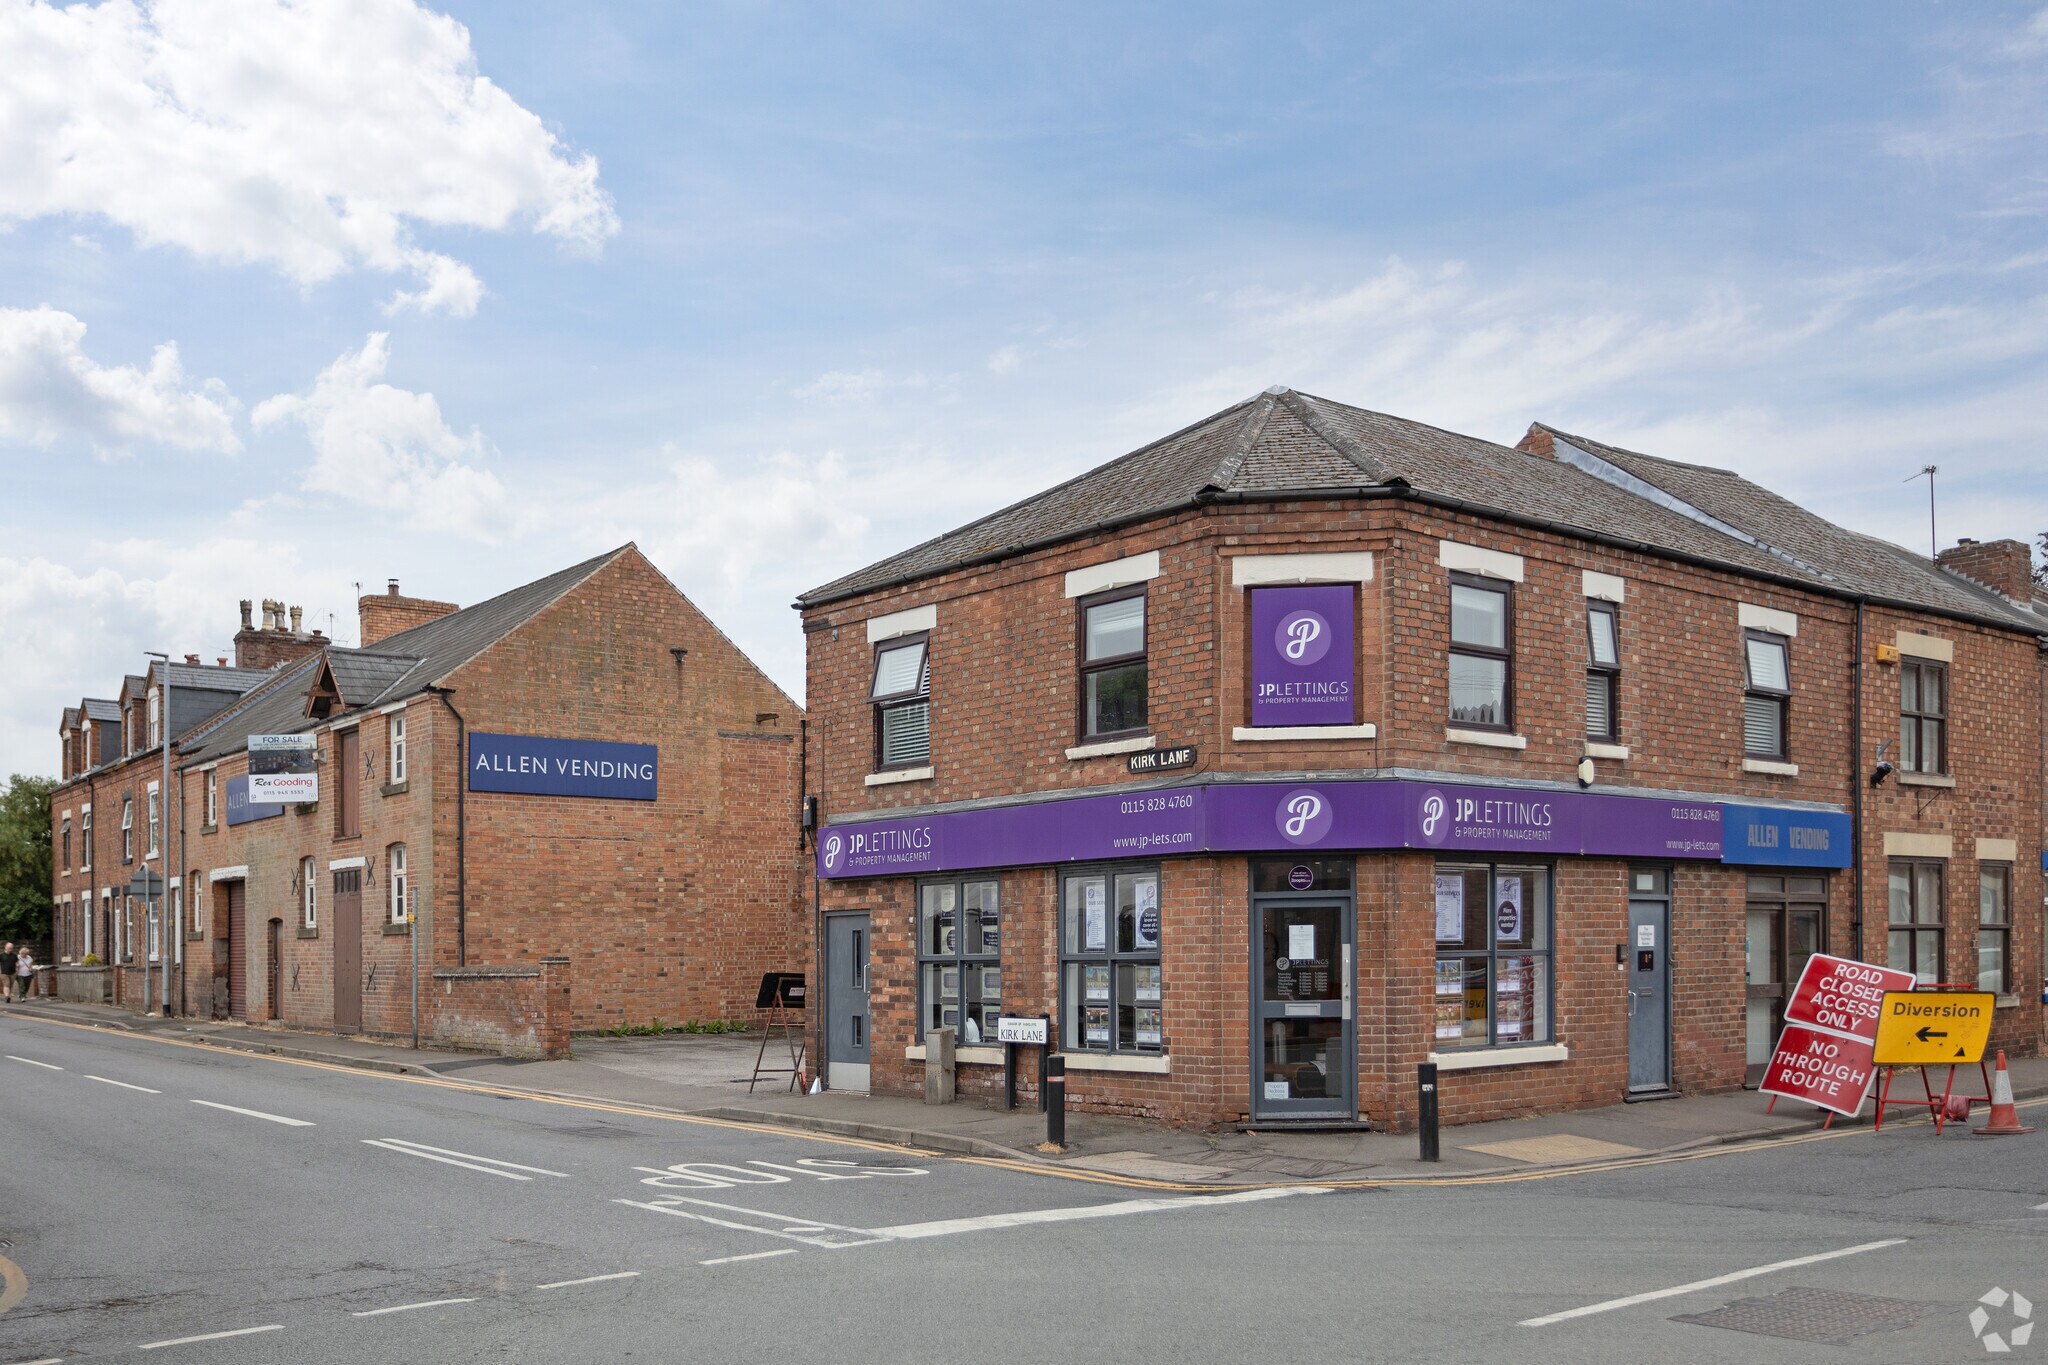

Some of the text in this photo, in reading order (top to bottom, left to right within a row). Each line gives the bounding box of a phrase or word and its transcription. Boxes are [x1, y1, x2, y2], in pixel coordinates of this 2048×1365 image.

[475, 753, 653, 780] ALLEN VENDING
[1130, 749, 1190, 769] KIRK LANE
[254, 778, 313, 787] Rex Gooding
[1121, 795, 1193, 814] 0115 828 4760
[1671, 808, 1720, 821] 0115 828 4760
[1113, 832, 1192, 849] www.jp-lets.com
[1455, 827, 1551, 841] & PROPERTY MANAGEMENT
[1747, 824, 1830, 850] ALLEN VENDING
[1665, 839, 1720, 852] www.jp-lets.com
[849, 851, 931, 866] & PROPERTY MANAGEMENT
[1834, 964, 1883, 985] ROAD
[1819, 977, 1884, 1002] CLOSED
[1810, 991, 1880, 1018] ACCESS
[1893, 1002, 1980, 1018] Diversion
[1816, 1010, 1862, 1031] ONLY
[1000, 1029, 1043, 1041] KIRK LANE
[1808, 1040, 1839, 1058] NO
[1776, 1051, 1866, 1086] THROUGH
[1779, 1070, 1841, 1096] ROUTE
